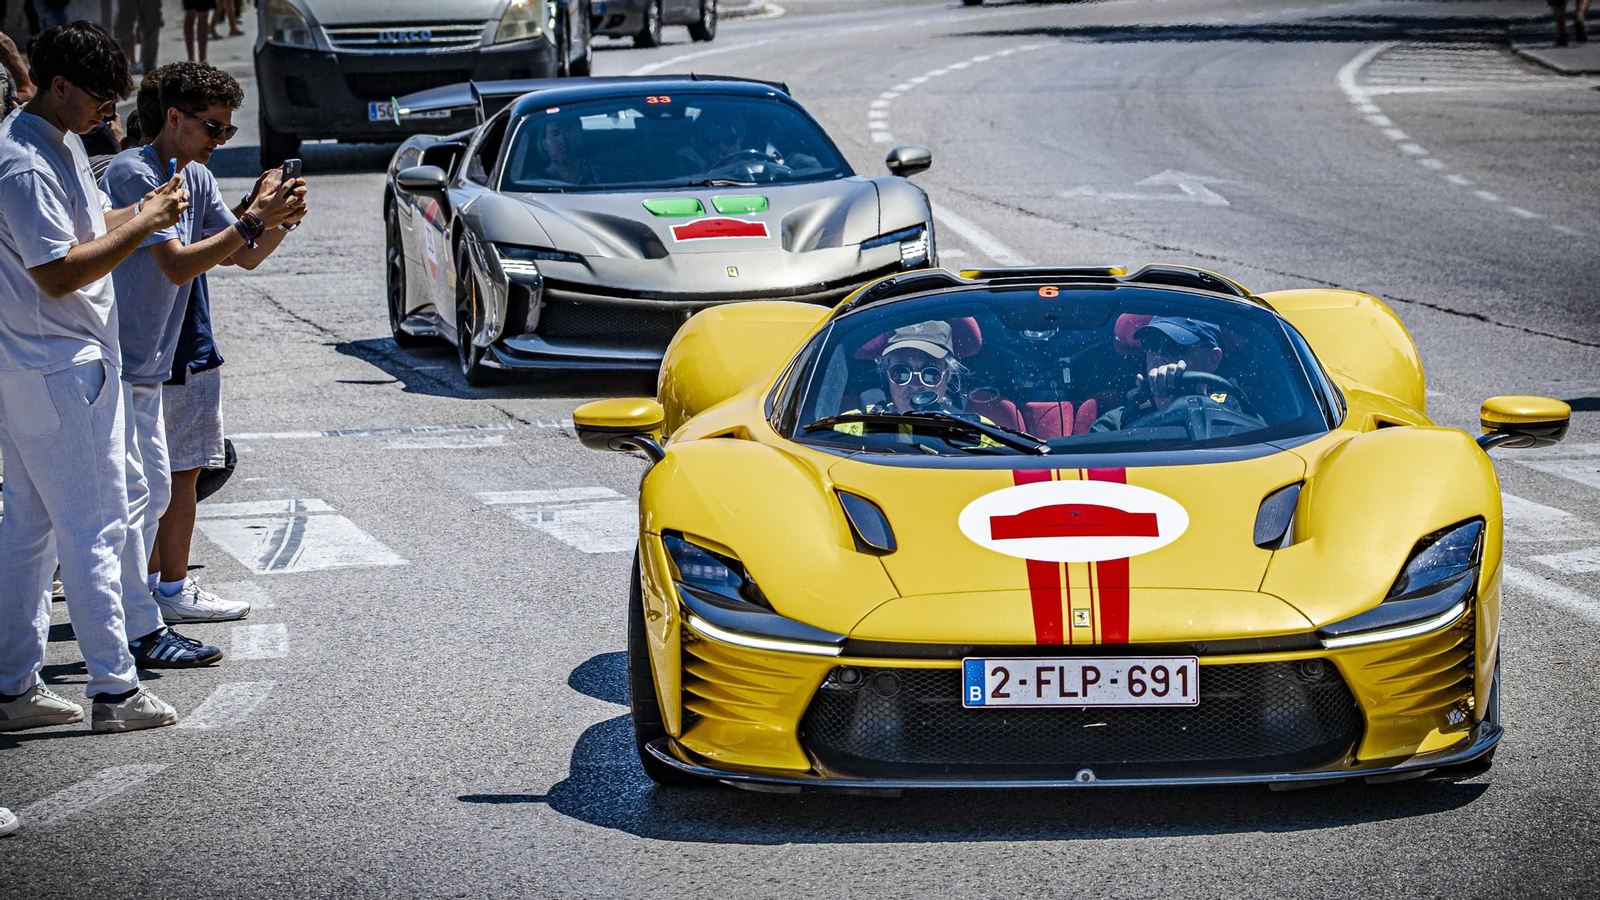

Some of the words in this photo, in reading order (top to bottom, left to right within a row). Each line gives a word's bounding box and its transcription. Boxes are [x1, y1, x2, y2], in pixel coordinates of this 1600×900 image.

[379, 29, 432, 41] IVECO
[646, 95, 671, 104] 33
[1038, 285, 1059, 298] 6
[991, 665, 1188, 698] 2-FLP-691
[969, 686, 982, 702] B
